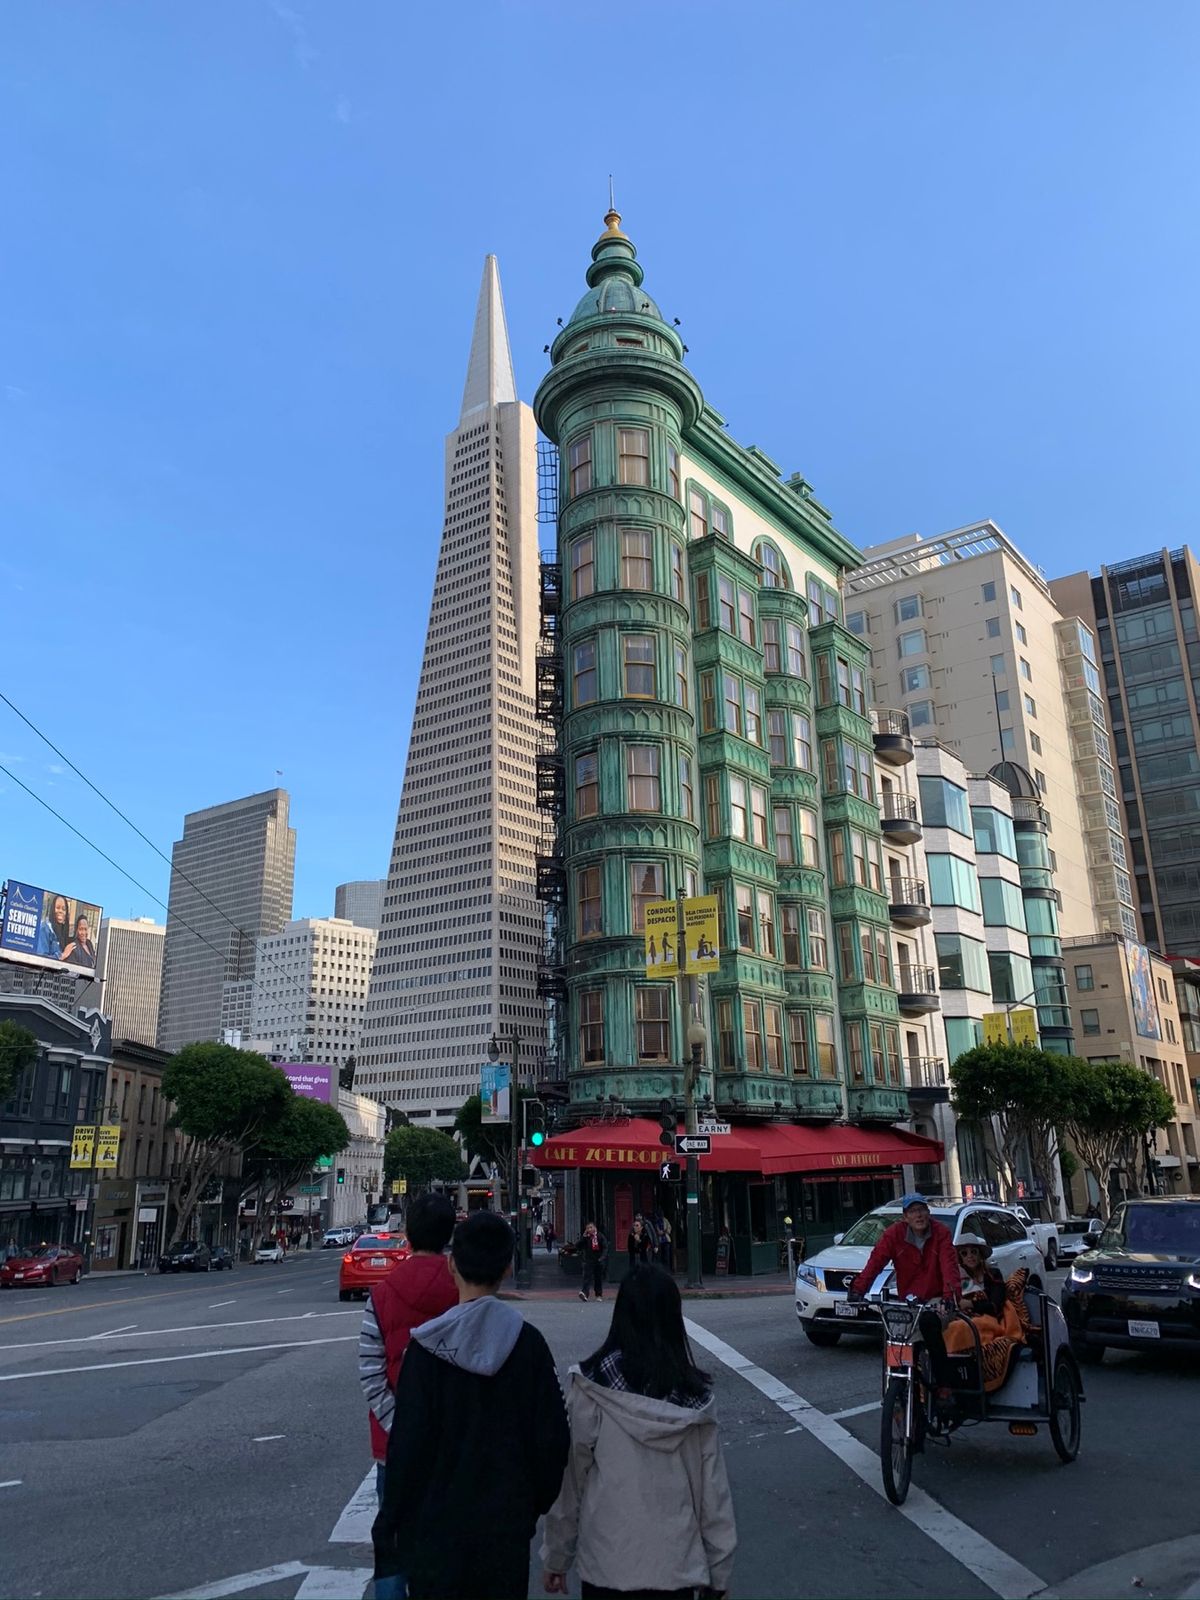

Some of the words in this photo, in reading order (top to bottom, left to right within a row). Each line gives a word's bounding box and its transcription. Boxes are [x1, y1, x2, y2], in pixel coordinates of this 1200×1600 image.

[647, 906, 675, 915] CONDUCE
[8, 908, 38, 927] SERVING
[647, 916, 676, 924] DESPACIO
[7, 922, 36, 938] EVERYONE
[314, 1075, 329, 1084] gives
[698, 1125, 729, 1133] EARNY
[544, 1147, 578, 1160] CAFE
[1102, 1267, 1174, 1275] DISCOVERY
